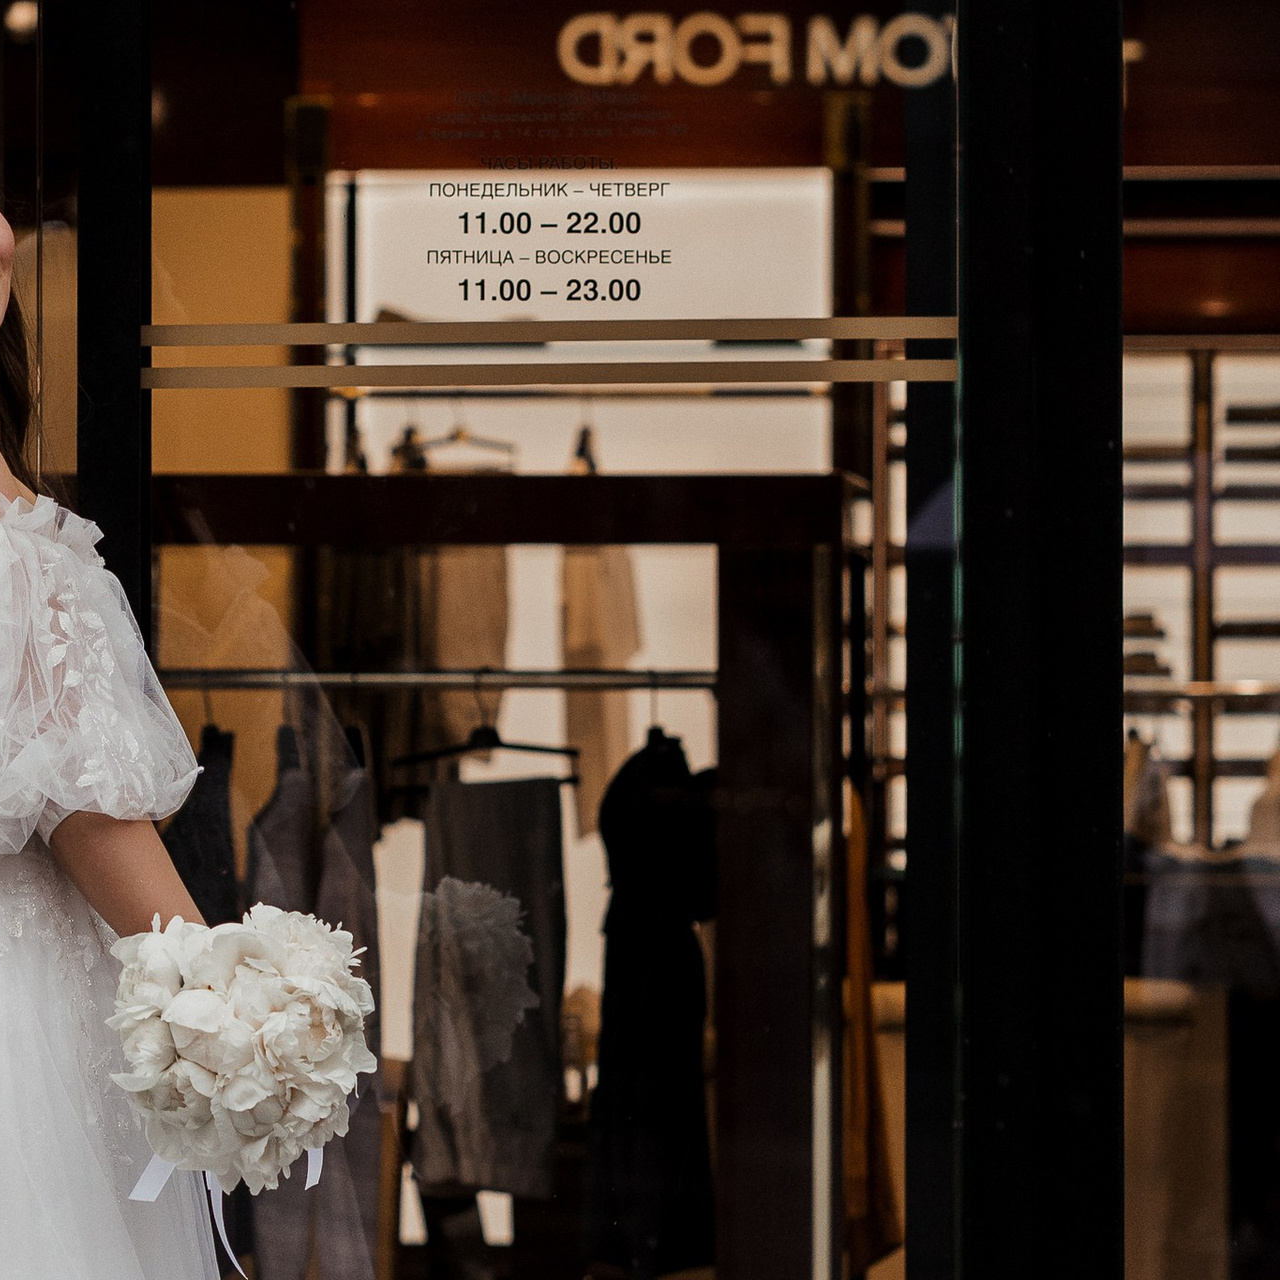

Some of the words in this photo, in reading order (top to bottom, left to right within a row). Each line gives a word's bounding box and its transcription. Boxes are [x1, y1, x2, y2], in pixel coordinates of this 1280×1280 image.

[429, 182, 568, 200] ПОНЕДЕЛЬНИК
[589, 182, 671, 197] ЧЕТВЕРГ
[458, 212, 532, 234] 11.00
[566, 212, 642, 234] 22.00
[426, 250, 515, 266] ПЯТНИЦА
[535, 250, 672, 265] ВОСКРЕСЕНЬЕ
[458, 279, 532, 301] 11.00
[566, 279, 642, 301] 23.00
